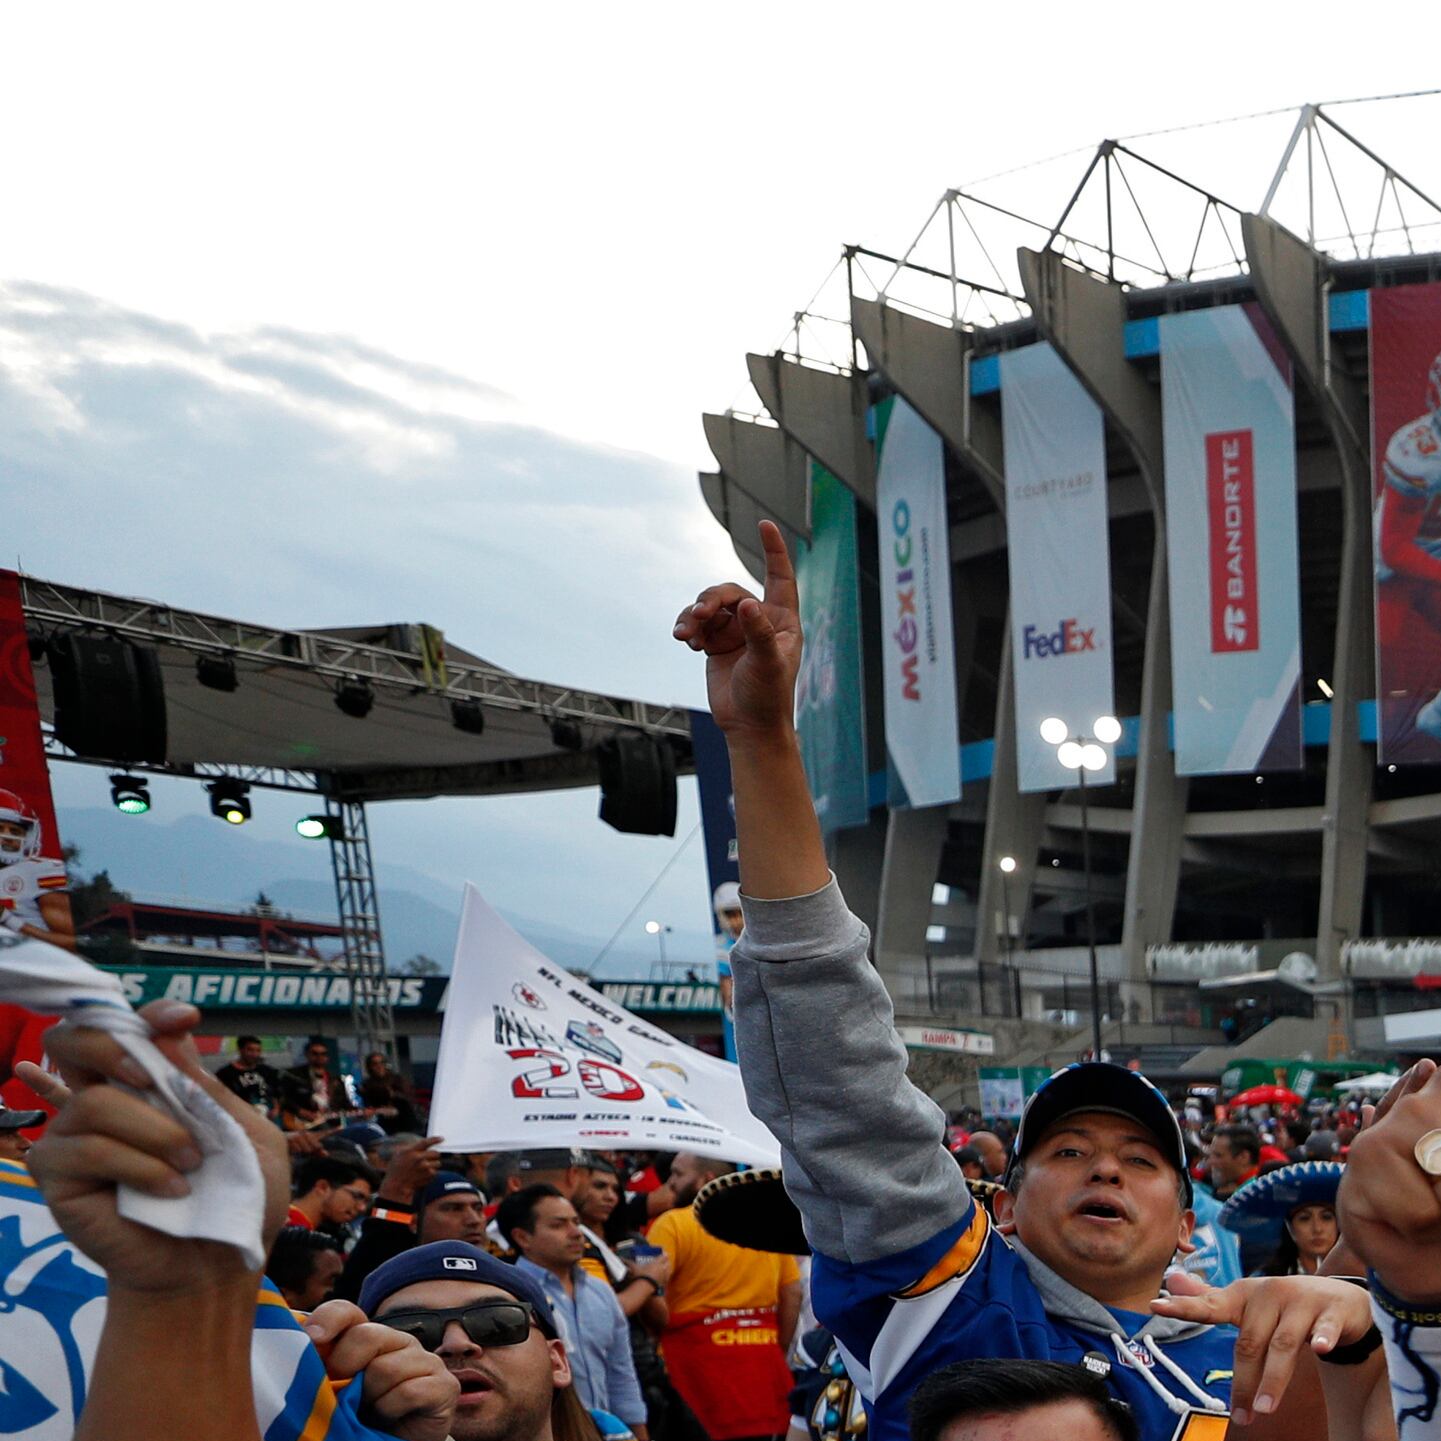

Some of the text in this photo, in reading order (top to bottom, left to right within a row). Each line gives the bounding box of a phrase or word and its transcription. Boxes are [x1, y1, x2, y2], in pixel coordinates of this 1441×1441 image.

[1013, 471, 1094, 498] COURTYARD
[1221, 437, 1242, 603] BANORTE
[1022, 618, 1096, 659] FedEx
[536, 966, 563, 989] NFL
[566, 989, 624, 1026] MEXICO
[601, 983, 724, 1010] WELCOM
[921, 1031, 957, 1045] RAMPA
